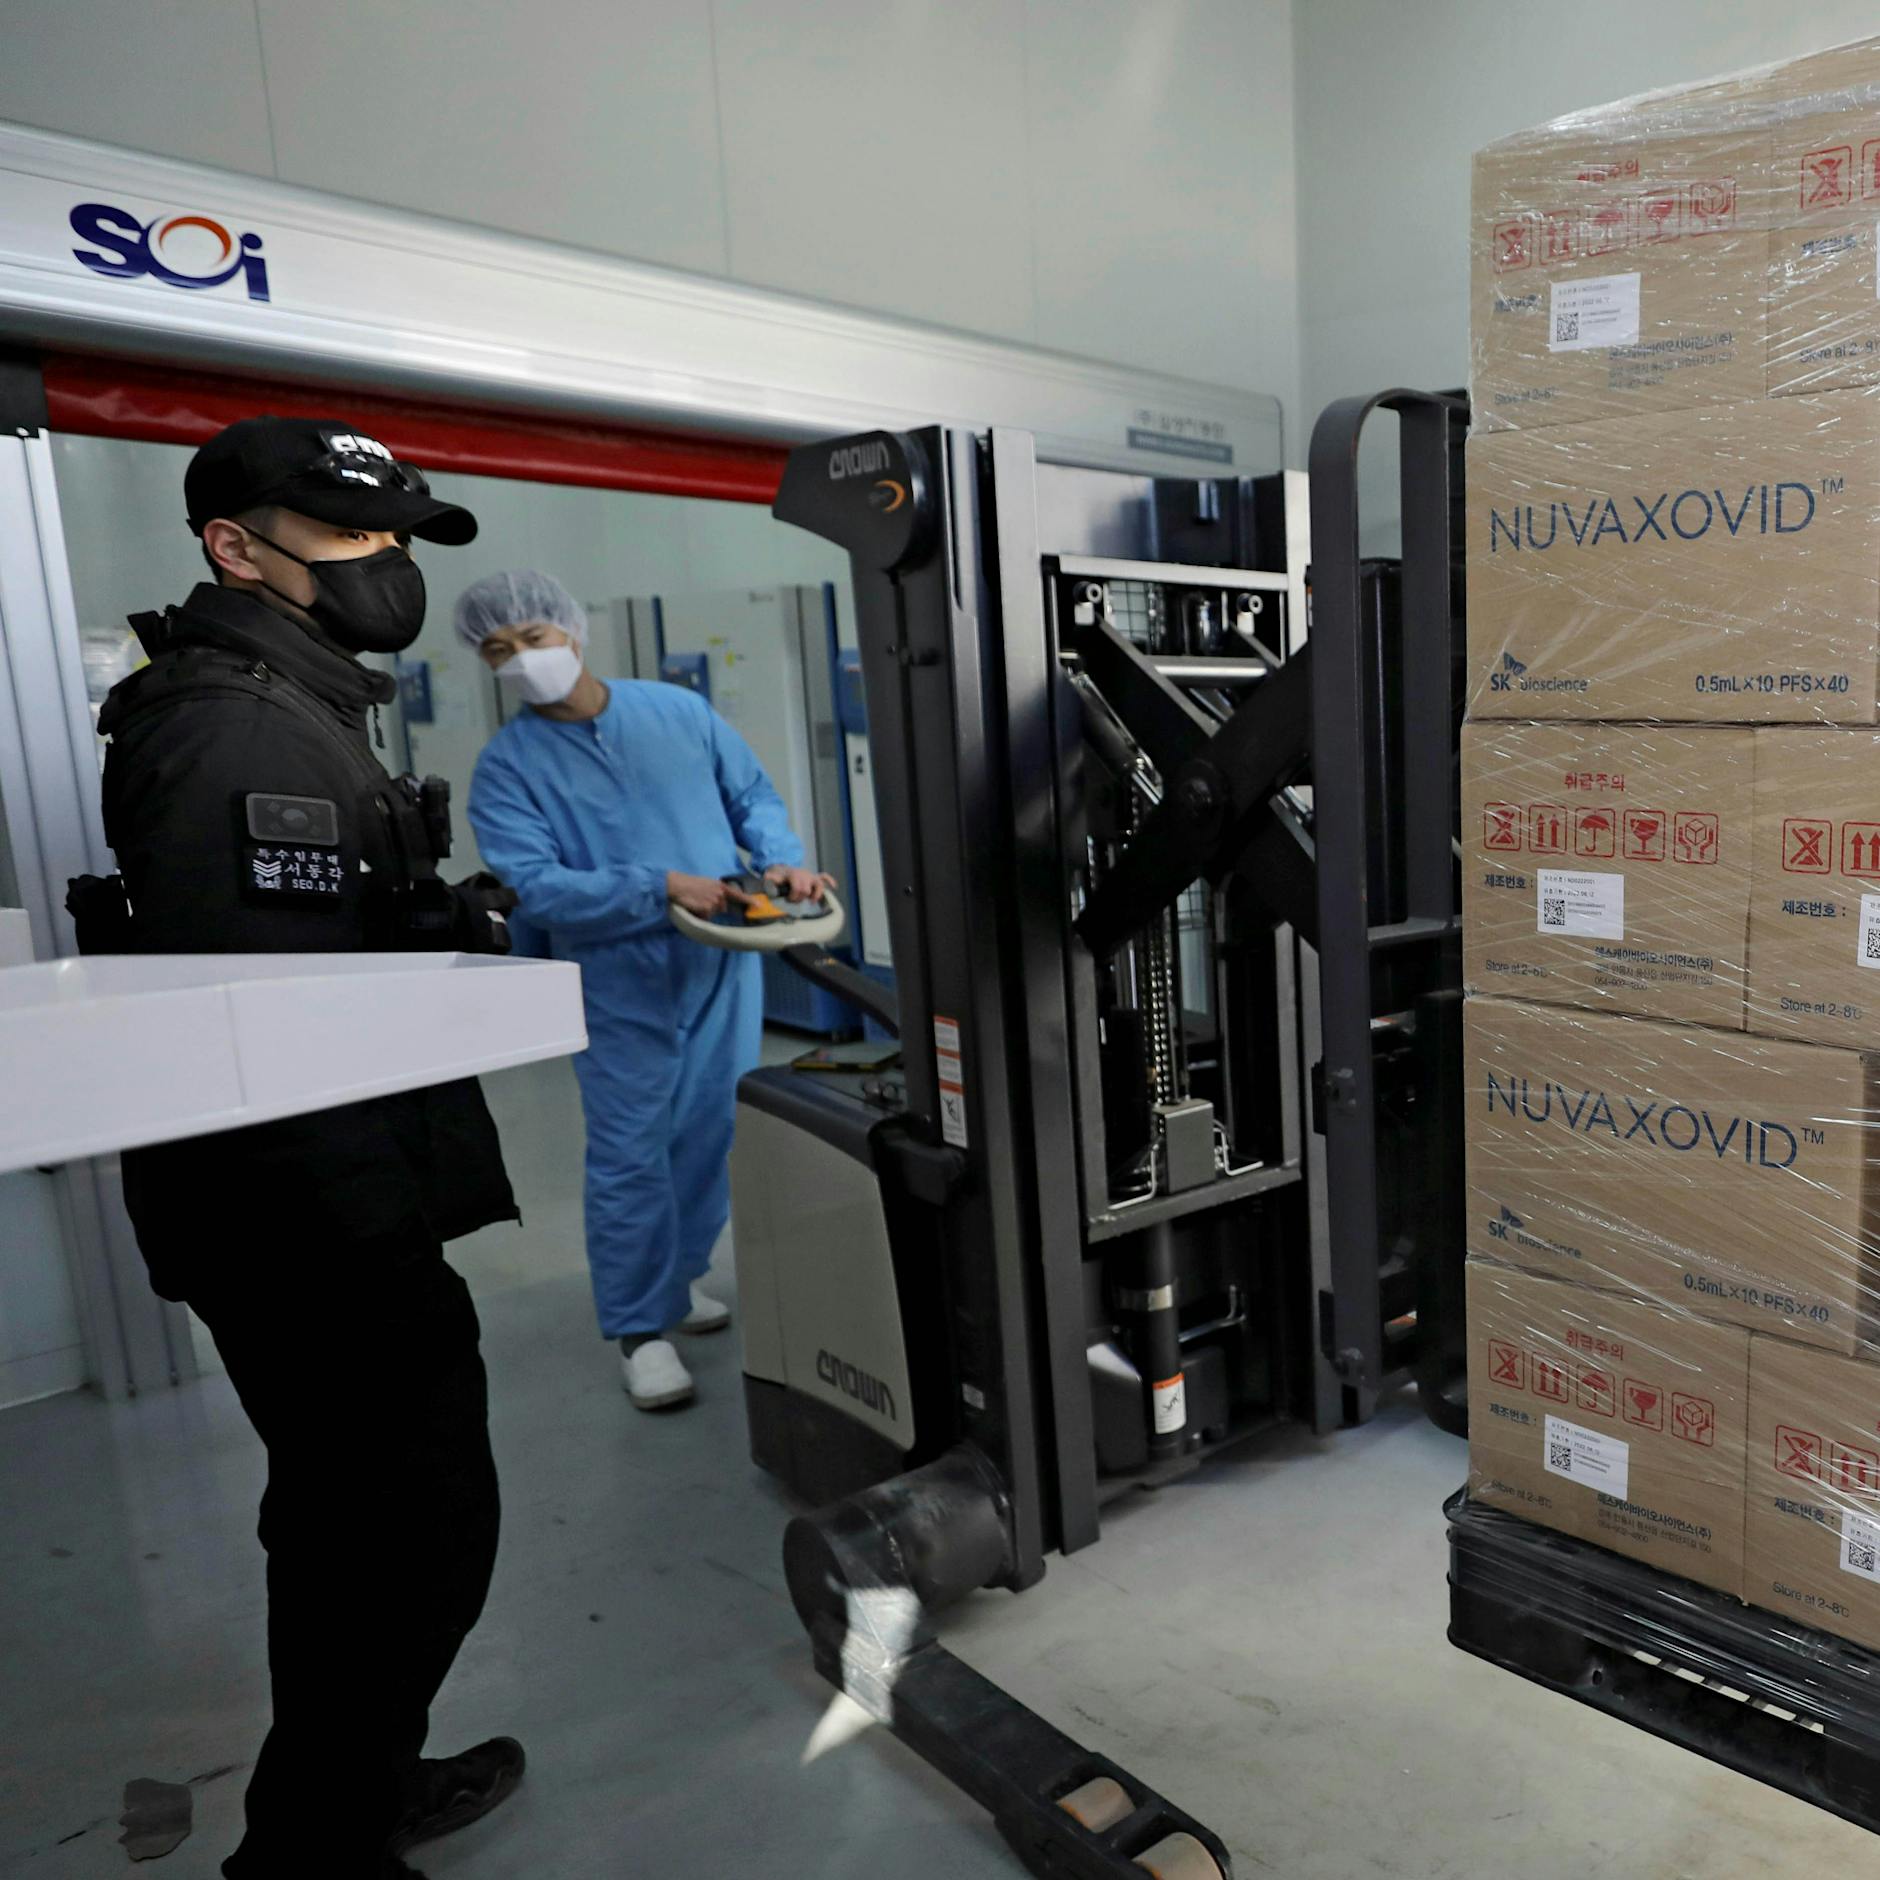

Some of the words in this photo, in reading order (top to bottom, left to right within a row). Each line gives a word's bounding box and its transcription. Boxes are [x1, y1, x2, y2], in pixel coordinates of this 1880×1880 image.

[1491, 482, 1815, 553] NUVAXOVID
[1491, 673, 1511, 691] SK
[1484, 873, 1527, 889] 제조번호
[1782, 899, 1836, 917] 제조번호
[1780, 996, 1812, 1012] Store
[1814, 1002, 1825, 1014] at
[1487, 1072, 1798, 1169] NUVAXOVID
[1489, 1220, 1508, 1241] SK
